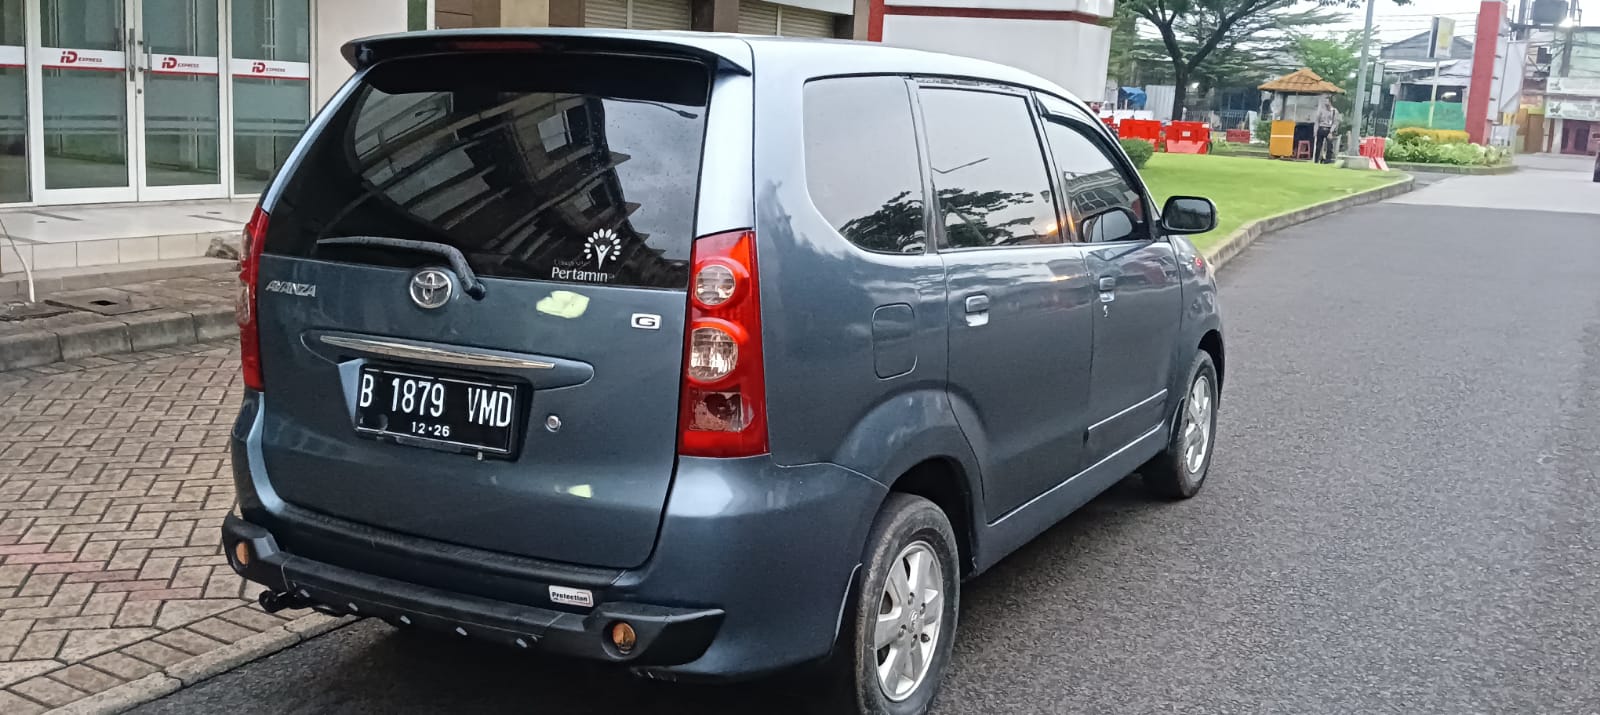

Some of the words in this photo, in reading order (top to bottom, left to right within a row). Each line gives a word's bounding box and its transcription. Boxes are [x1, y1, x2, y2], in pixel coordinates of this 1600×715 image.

[265, 280, 317, 297] AVANZA
[635, 316, 656, 327] G
[359, 374, 374, 408] B
[391, 377, 445, 418] 1879
[467, 387, 512, 428] VMD
[551, 591, 588, 601] Protection
